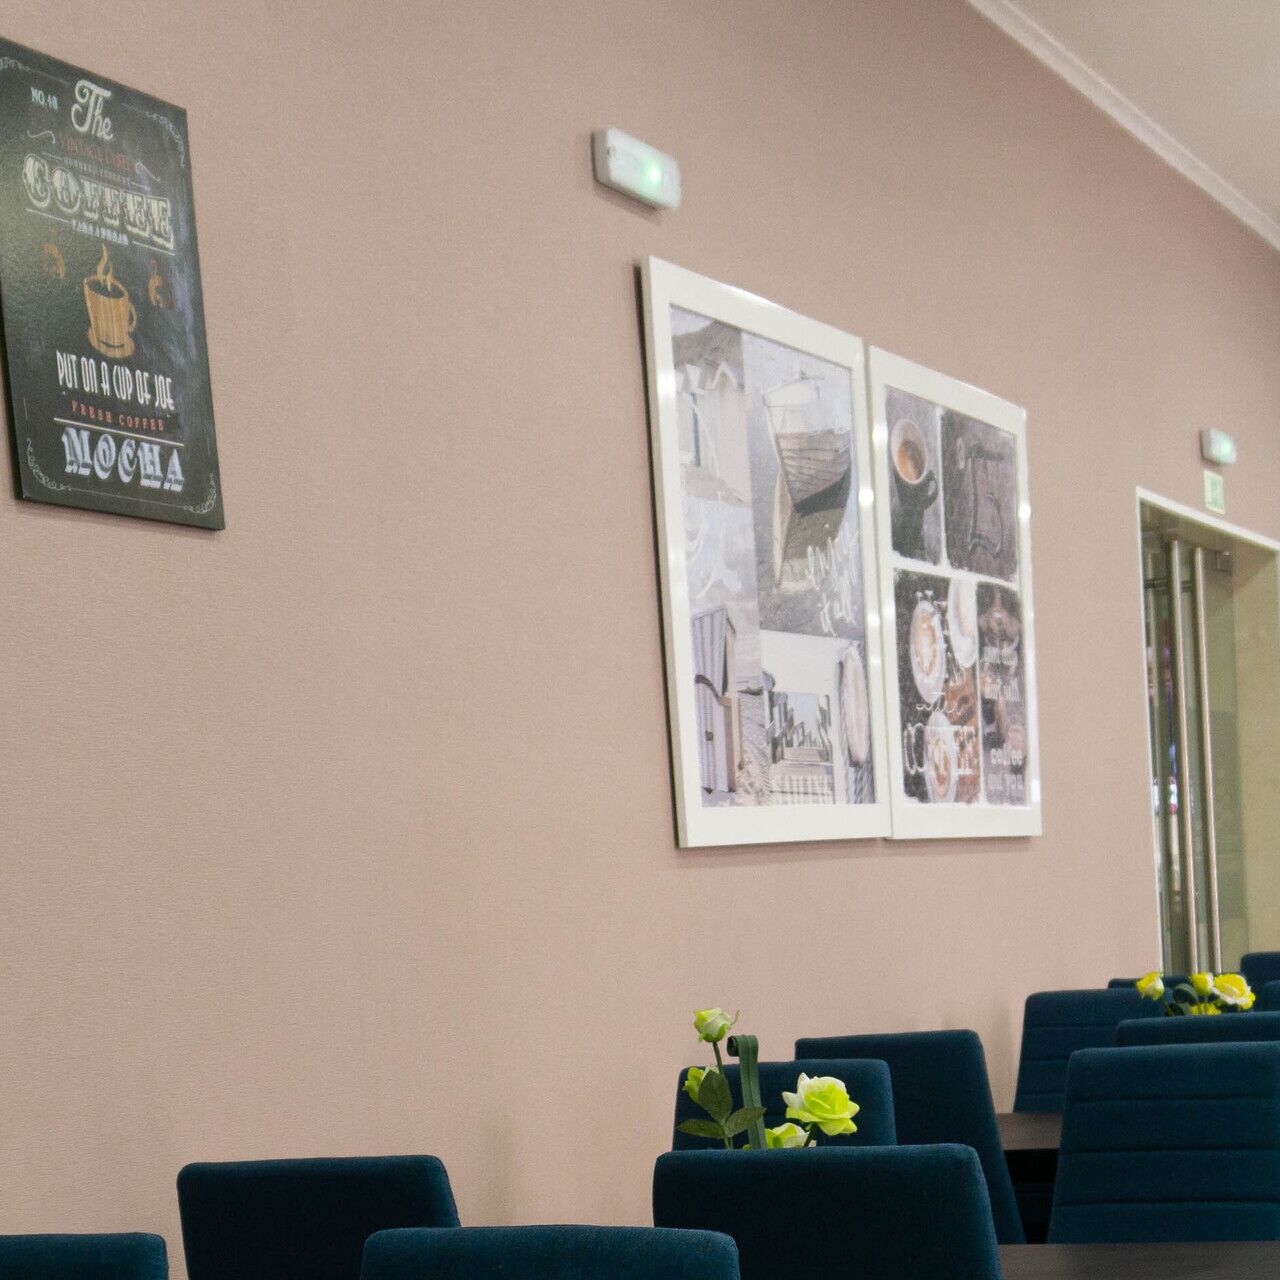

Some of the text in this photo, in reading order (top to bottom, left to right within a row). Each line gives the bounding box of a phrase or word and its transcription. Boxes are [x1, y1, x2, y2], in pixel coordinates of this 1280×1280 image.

[71, 79, 114, 140] The
[22, 153, 174, 249] COFFEE
[56, 350, 175, 411] PUT ON A CUP OF JOE
[71, 400, 164, 432] FRESH COFFEE
[61, 427, 185, 492] MOCHA
